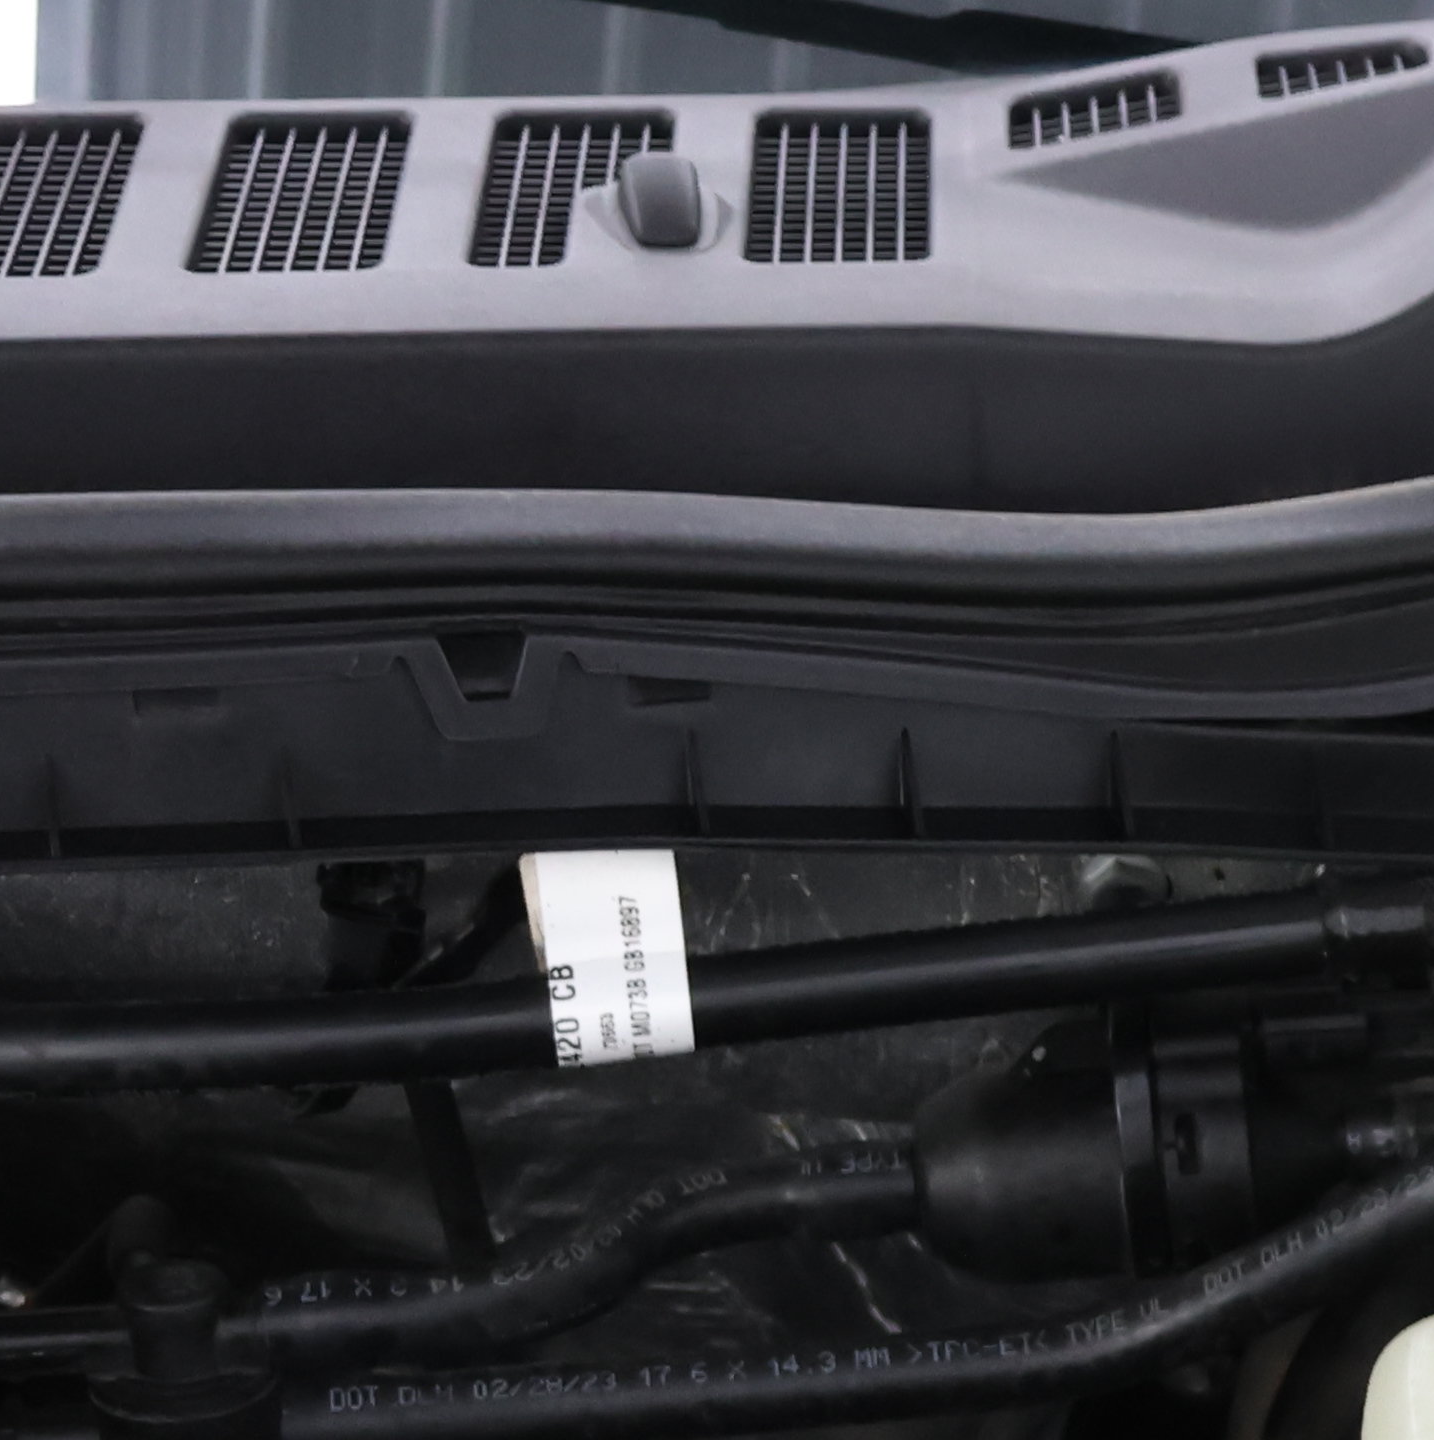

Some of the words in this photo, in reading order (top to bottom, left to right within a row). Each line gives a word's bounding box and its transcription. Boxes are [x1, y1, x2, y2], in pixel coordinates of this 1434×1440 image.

[550, 963, 576, 1002] CB
[555, 1018, 582, 1067] 420
[328, 1383, 378, 1414] DOT
[854, 1345, 892, 1370] MM
